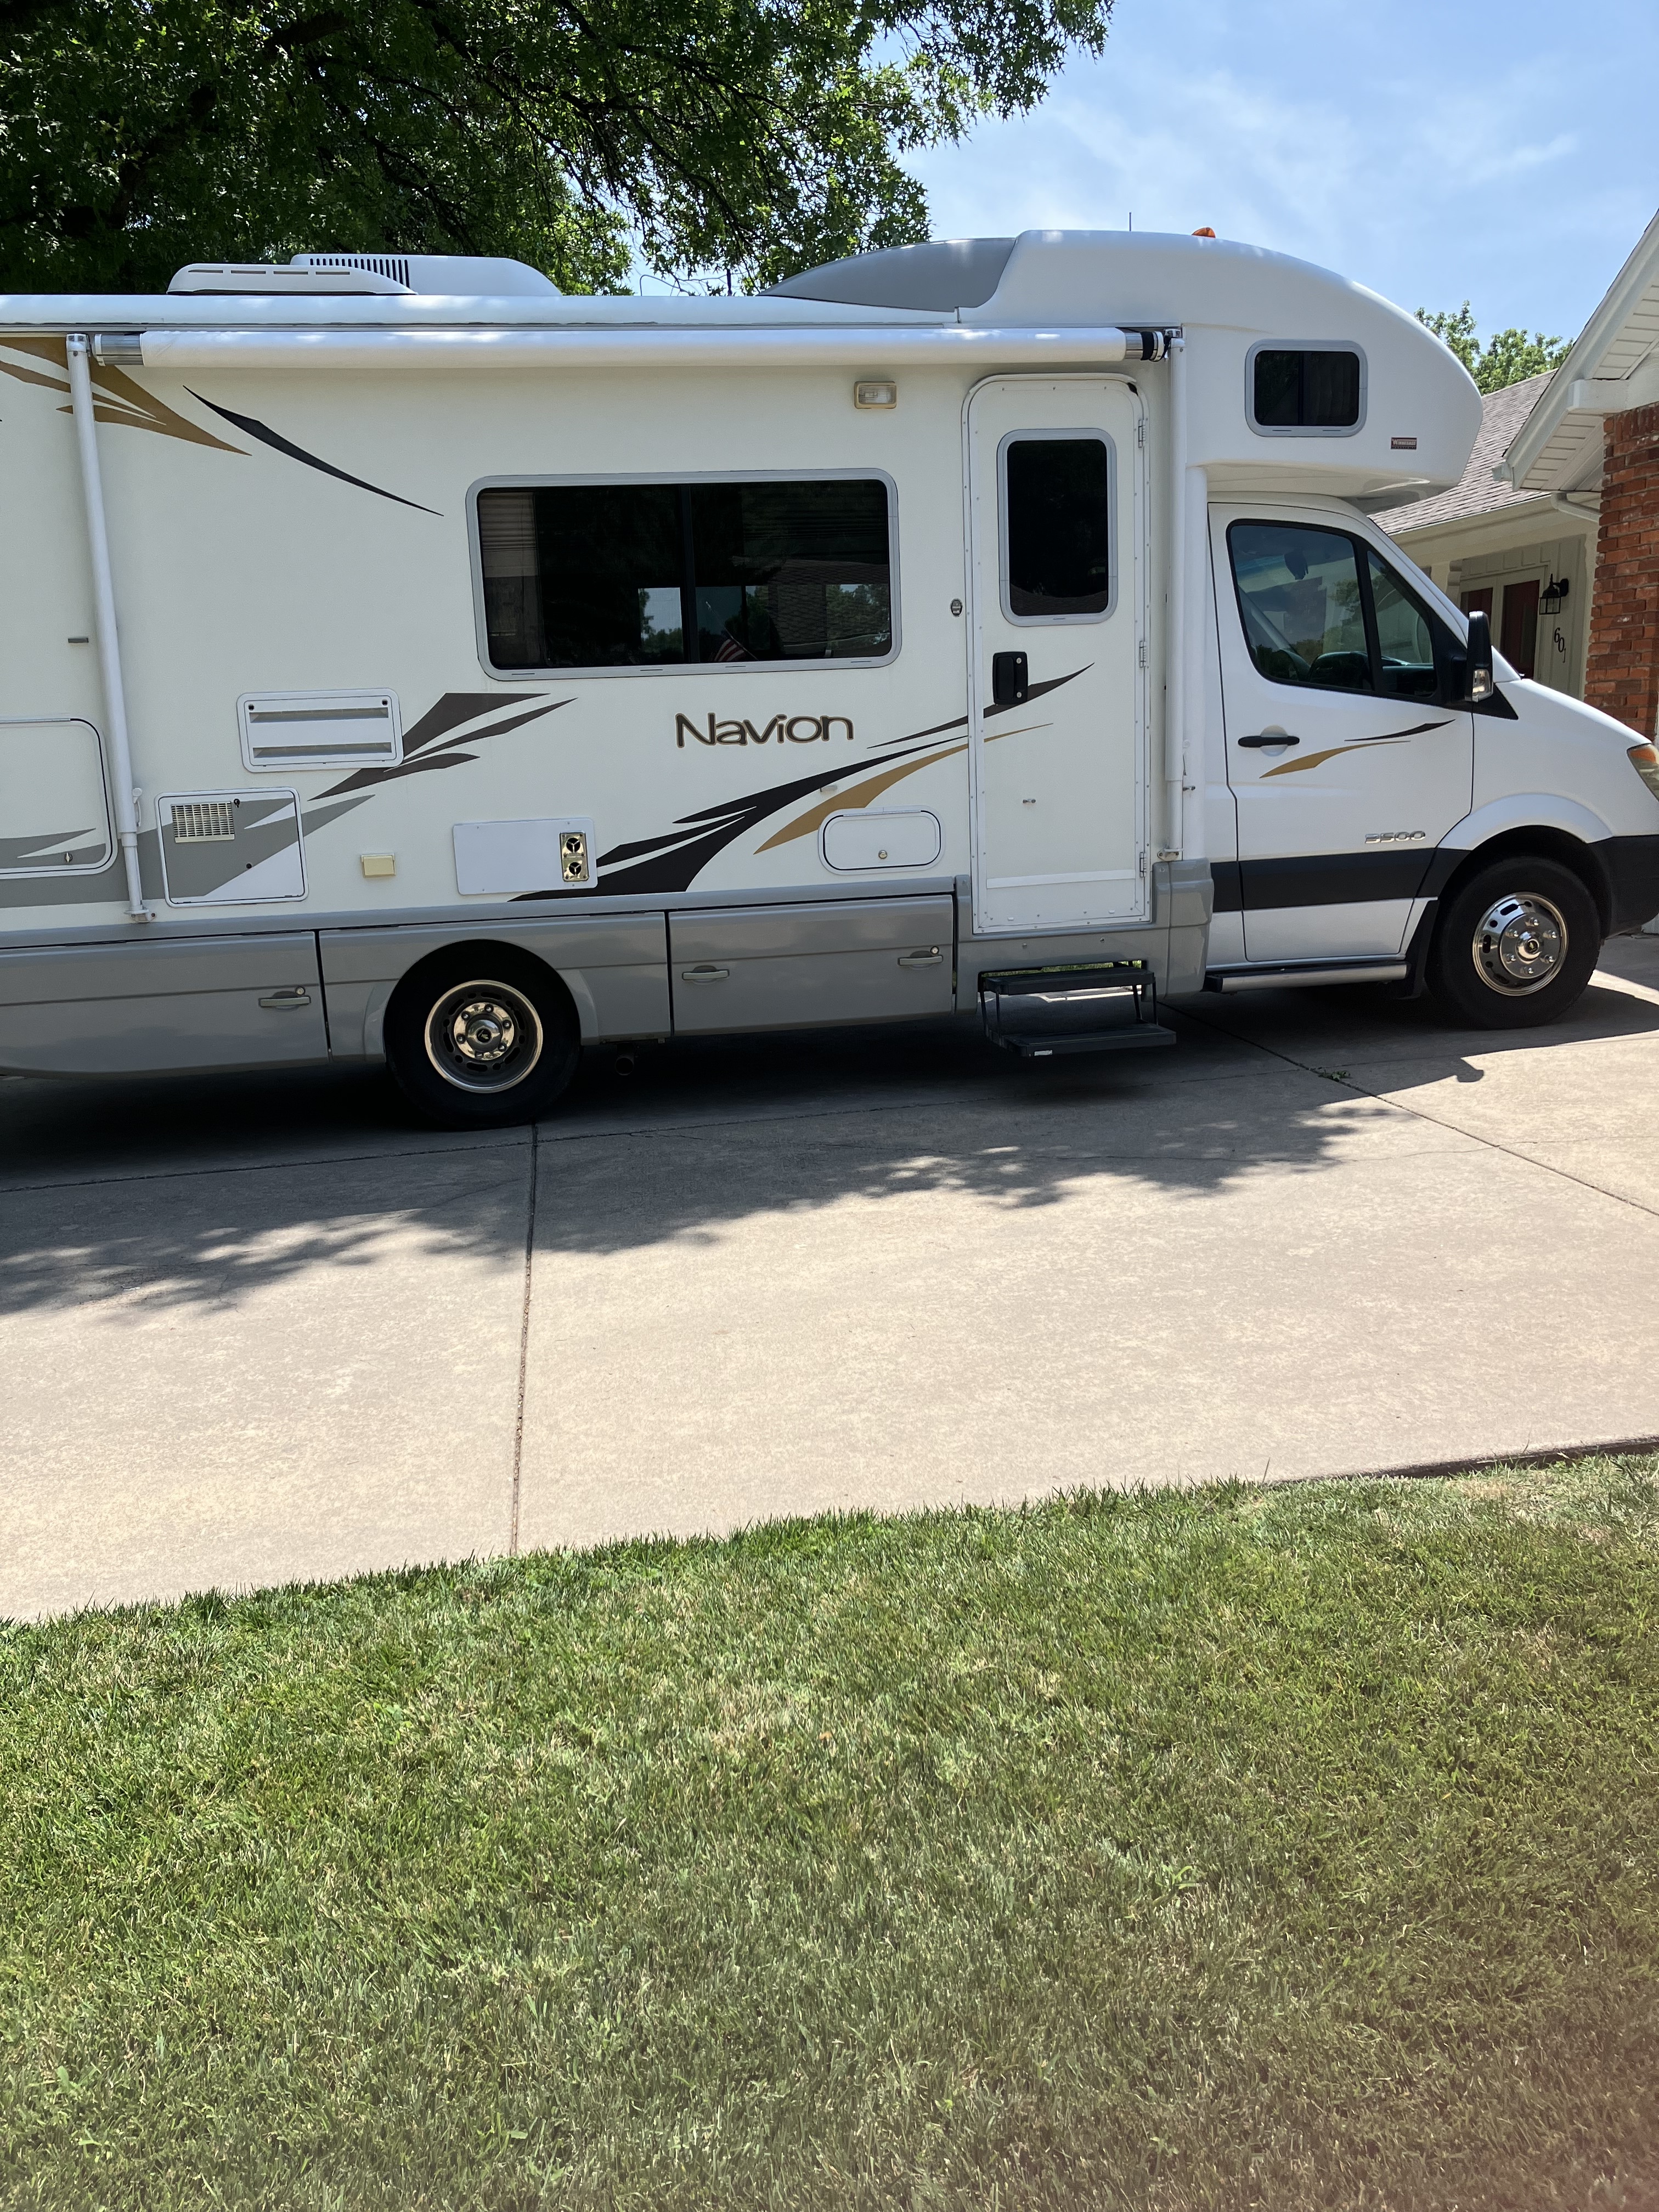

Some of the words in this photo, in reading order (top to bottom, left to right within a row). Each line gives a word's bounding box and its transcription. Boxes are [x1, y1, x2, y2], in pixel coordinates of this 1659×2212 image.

[1554, 627, 1566, 663] 601
[675, 712, 854, 748] Navion
[1364, 830, 1426, 844] 3500
